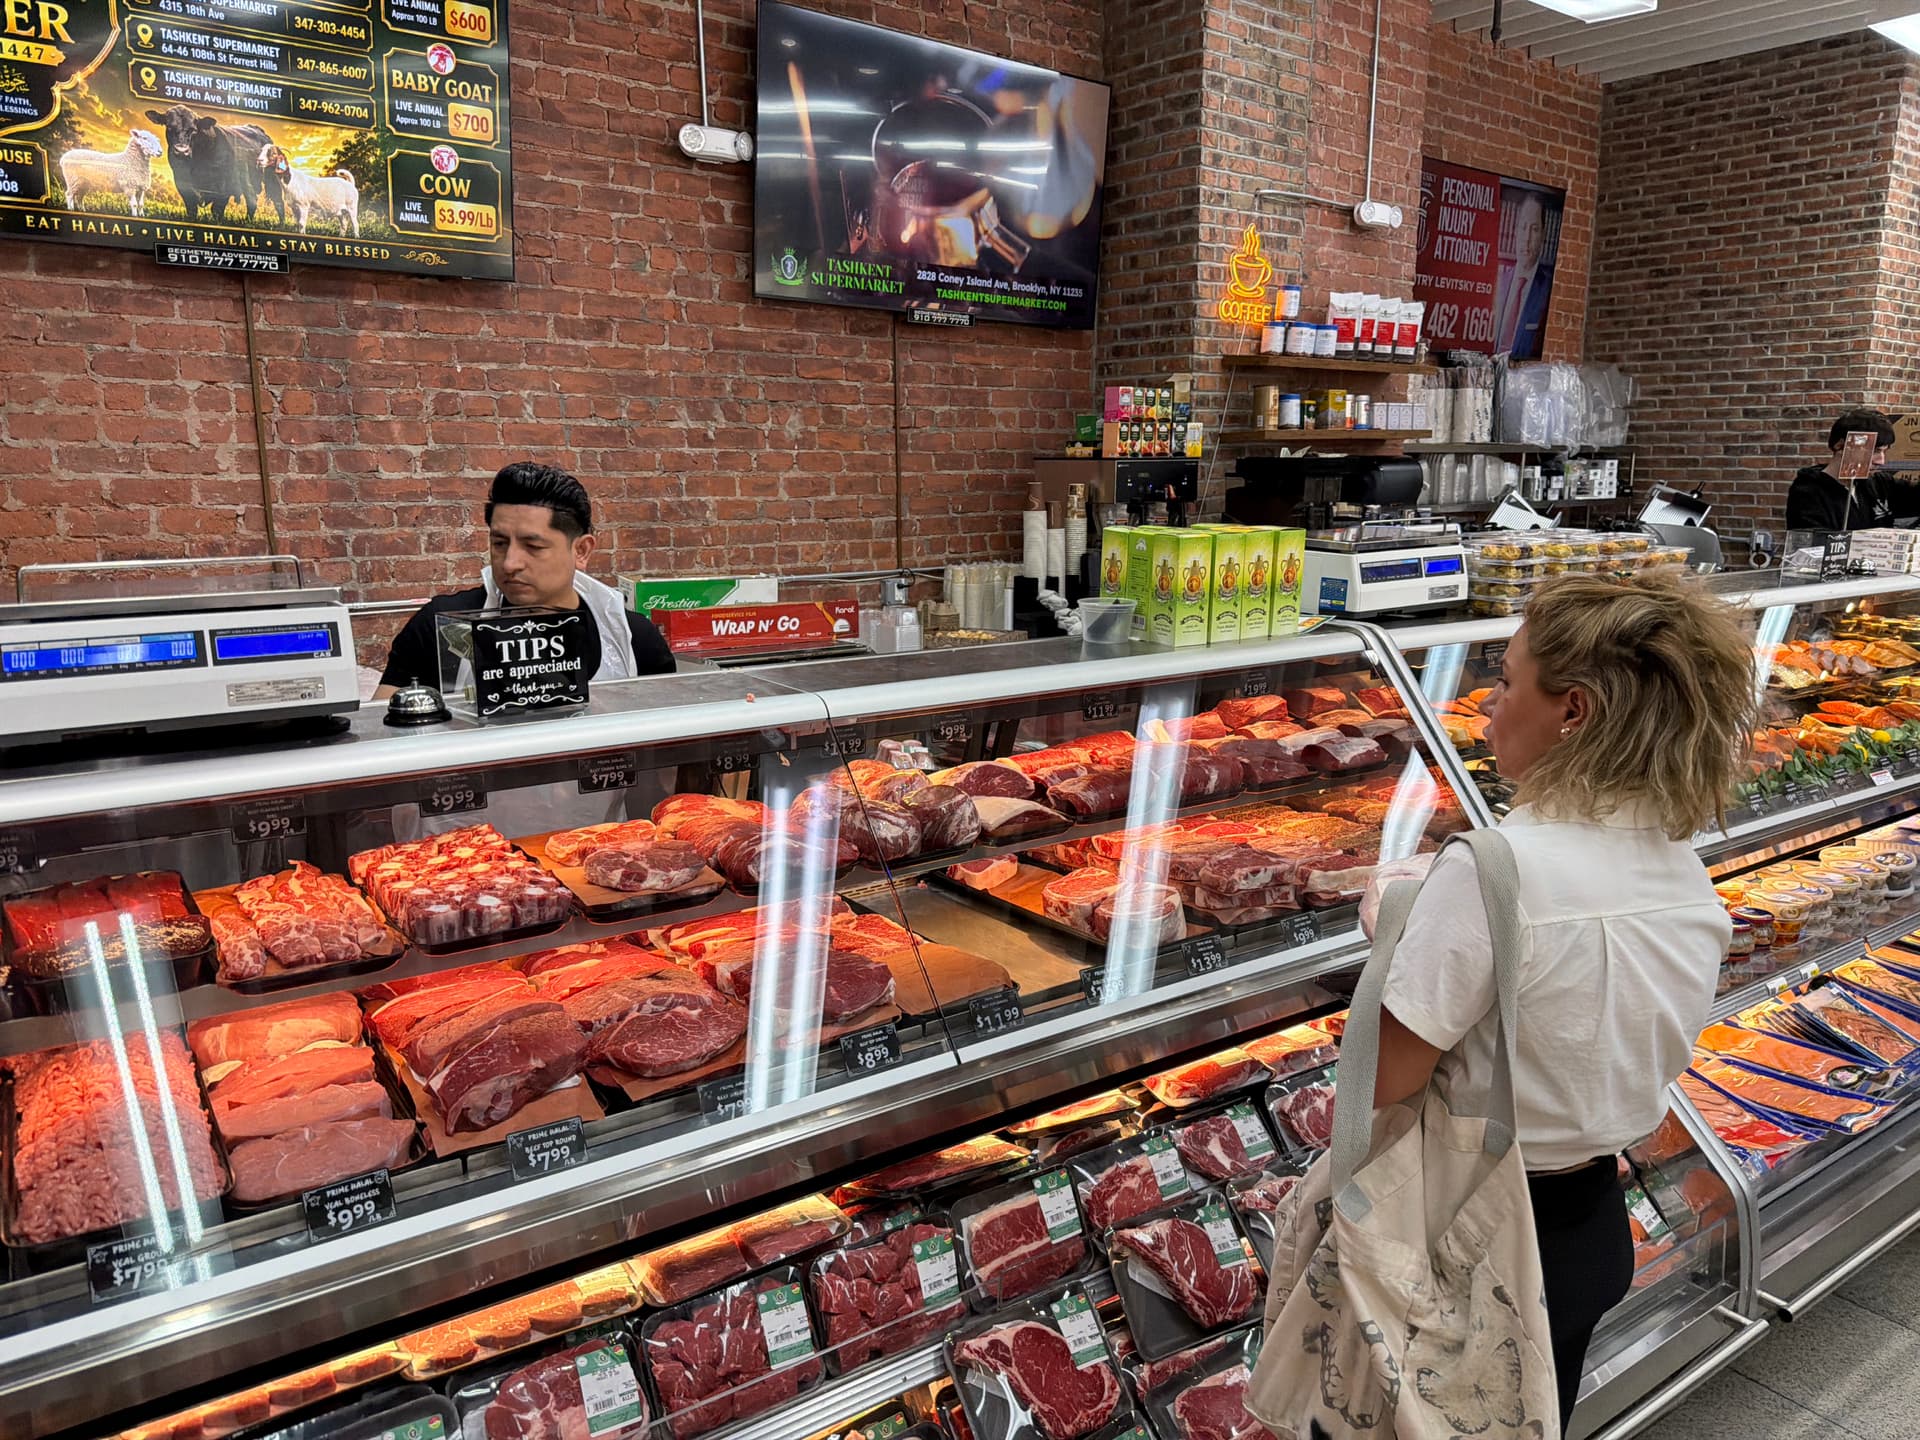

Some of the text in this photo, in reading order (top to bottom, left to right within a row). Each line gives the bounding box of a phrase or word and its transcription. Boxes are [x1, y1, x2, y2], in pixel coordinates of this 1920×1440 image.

[159, 0, 225, 20] 4315 18th Ave
[391, 9, 438, 26] Approx 100 LB
[410, 0, 441, 14] ANIMAL
[294, 16, 366, 40] 347-303-4454
[450, 9, 486, 33] $600
[160, 28, 281, 58] TASHKENT SUPERMARKET
[161, 43, 278, 71] 64-46 108th St Forrest Hills
[296, 57, 367, 80] 347-865-6007
[163, 71, 283, 99] TASHKENT SUPERMARKET
[392, 69, 492, 104] BABY GOAT
[165, 86, 183, 98] 378
[185, 89, 201, 101] 6th
[227, 95, 240, 106] NY
[244, 97, 269, 111] 10011
[299, 98, 369, 119] 347-962-0704
[395, 100, 444, 117] LIVE ANIMAL
[395, 114, 441, 129] Approx 100 LB
[453, 112, 489, 134] $700
[419, 173, 472, 199] COW
[1441, 177, 1495, 212] PERSONAL
[404, 201, 422, 212] LIVE
[399, 212, 430, 225] ANIMAL
[439, 207, 494, 229] $3.99/Lb
[1437, 205, 1476, 236] INJURY
[25, 215, 390, 260] EAT HALAL LIVE HALAL STAY BLESSED
[168, 253, 279, 270] 910 777 7770
[1434, 235, 1490, 267] ATTORNEY
[827, 257, 893, 279] TASHKENT
[811, 271, 905, 294] SUPERMARKET
[916, 269, 936, 281] 2828
[938, 272, 965, 287] Coney
[966, 276, 993, 288] Island
[1049, 285, 1061, 295] NY
[1434, 276, 1475, 293] LEVITSKY
[1475, 282, 1493, 295] ESQ
[936, 288, 1067, 311] TASHKENTSUPERMARKET.COM
[1221, 299, 1272, 323] COFFEE
[1427, 302, 1459, 339] 462
[1830, 541, 1847, 554] TIPS
[643, 594, 701, 609] Prestige
[711, 620, 755, 637] WRAP
[495, 635, 565, 664] TIPS
[482, 657, 582, 680] are appreciated
[527, 1131, 548, 1141] PRIME
[326, 1177, 375, 1198] PRIME HALAL
[344, 1188, 381, 1205] BONELESS
[112, 1240, 142, 1254] PRIME
